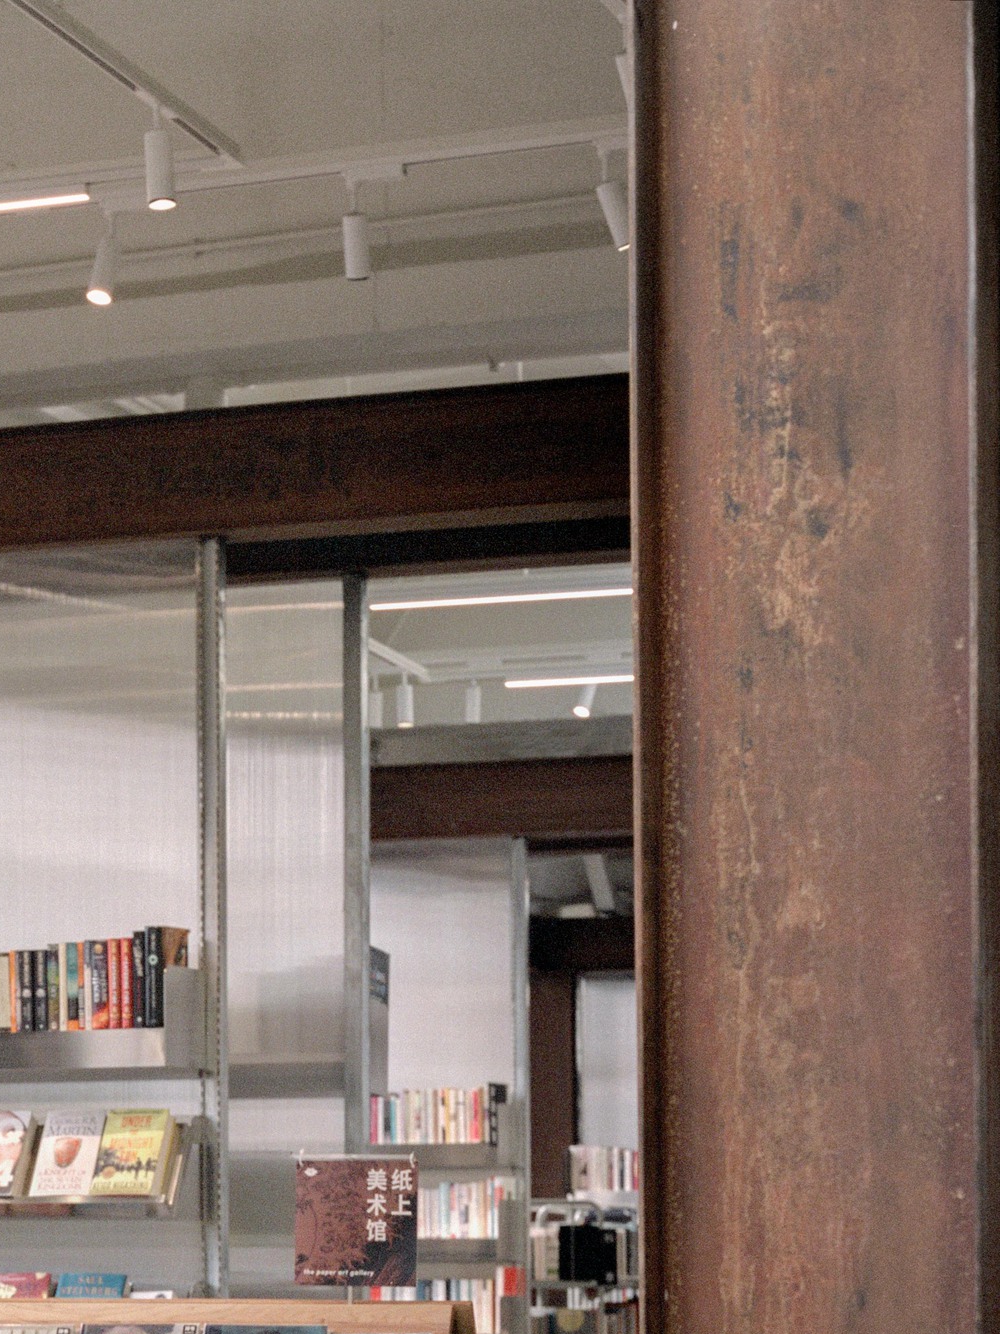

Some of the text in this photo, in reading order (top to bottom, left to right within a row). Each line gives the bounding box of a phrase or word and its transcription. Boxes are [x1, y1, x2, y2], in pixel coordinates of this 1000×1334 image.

[366, 1168, 388, 1242] 美术馆
[391, 1168, 413, 1216] 纸上
[316, 1269, 337, 1277] paper
[349, 1269, 375, 1278] gallery
